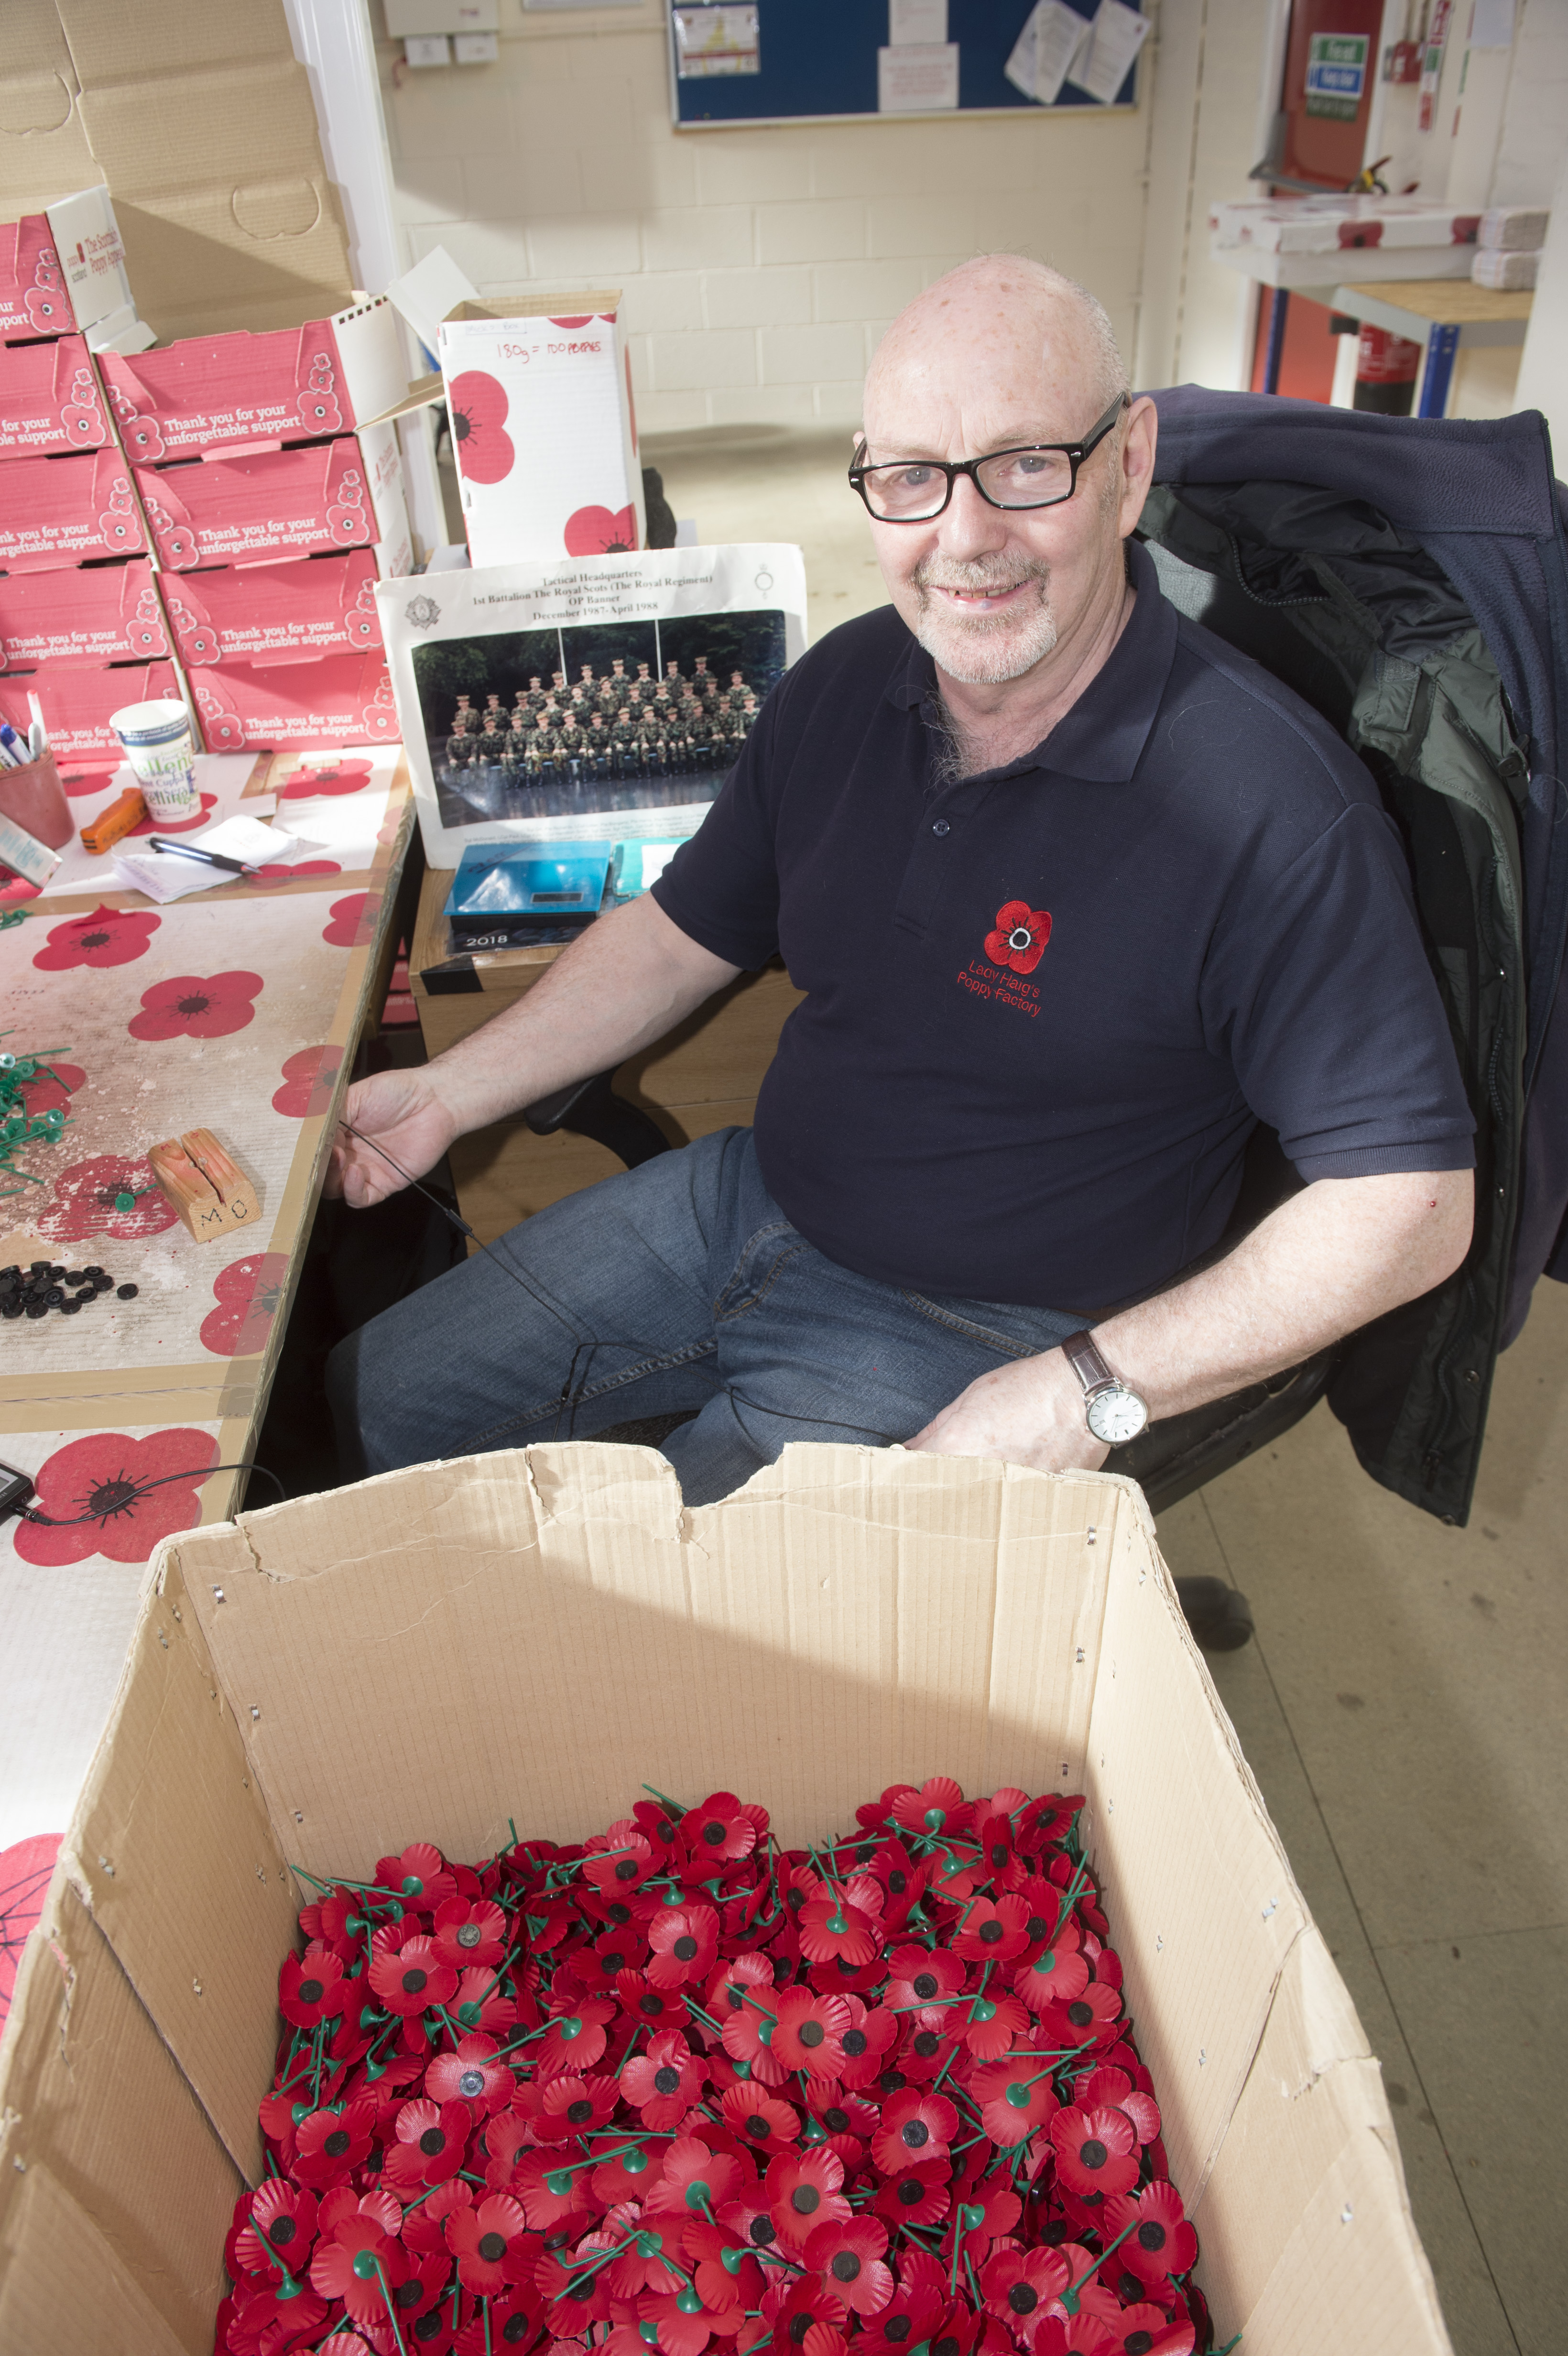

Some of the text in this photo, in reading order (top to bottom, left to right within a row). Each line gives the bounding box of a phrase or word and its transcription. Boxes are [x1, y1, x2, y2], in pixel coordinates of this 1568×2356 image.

[85, 238, 98, 254] The
[89, 255, 108, 276] Poppy
[1, 418, 51, 433] for your
[164, 405, 286, 432] Thank you for your
[17, 428, 66, 445] support
[164, 415, 301, 446] unforgettable support
[17, 530, 40, 543] you
[42, 525, 59, 538] for
[61, 524, 89, 539] your
[198, 518, 316, 542] Thank you for your
[56, 533, 104, 550] support
[197, 528, 330, 555] unforgettable support
[541, 570, 642, 587] Tactical Headquarters
[473, 575, 713, 605] 1st Battalion The Royal Scots (The Royal Regiment)
[569, 595, 620, 606] OP Banner
[533, 610, 580, 621] December
[636, 602, 658, 611] 1988
[7, 631, 117, 648] Thank you for your
[221, 621, 335, 641] Thank you for your
[7, 640, 130, 660] unforgettable support
[220, 631, 348, 653] unforgettable support
[245, 714, 353, 729] Thank you for your
[48, 729, 70, 740] ank
[71, 730, 94, 742] you
[95, 726, 111, 737] for
[244, 723, 365, 741] unforgettable support
[50, 737, 106, 753] orgettable
[466, 935, 508, 947] 2018
[969, 960, 1040, 998] Lady Haig's
[957, 971, 1041, 1017] Poppy Factory
[461, 1926, 476, 1937] POPPY
[462, 1931, 478, 1944] APPEAL
